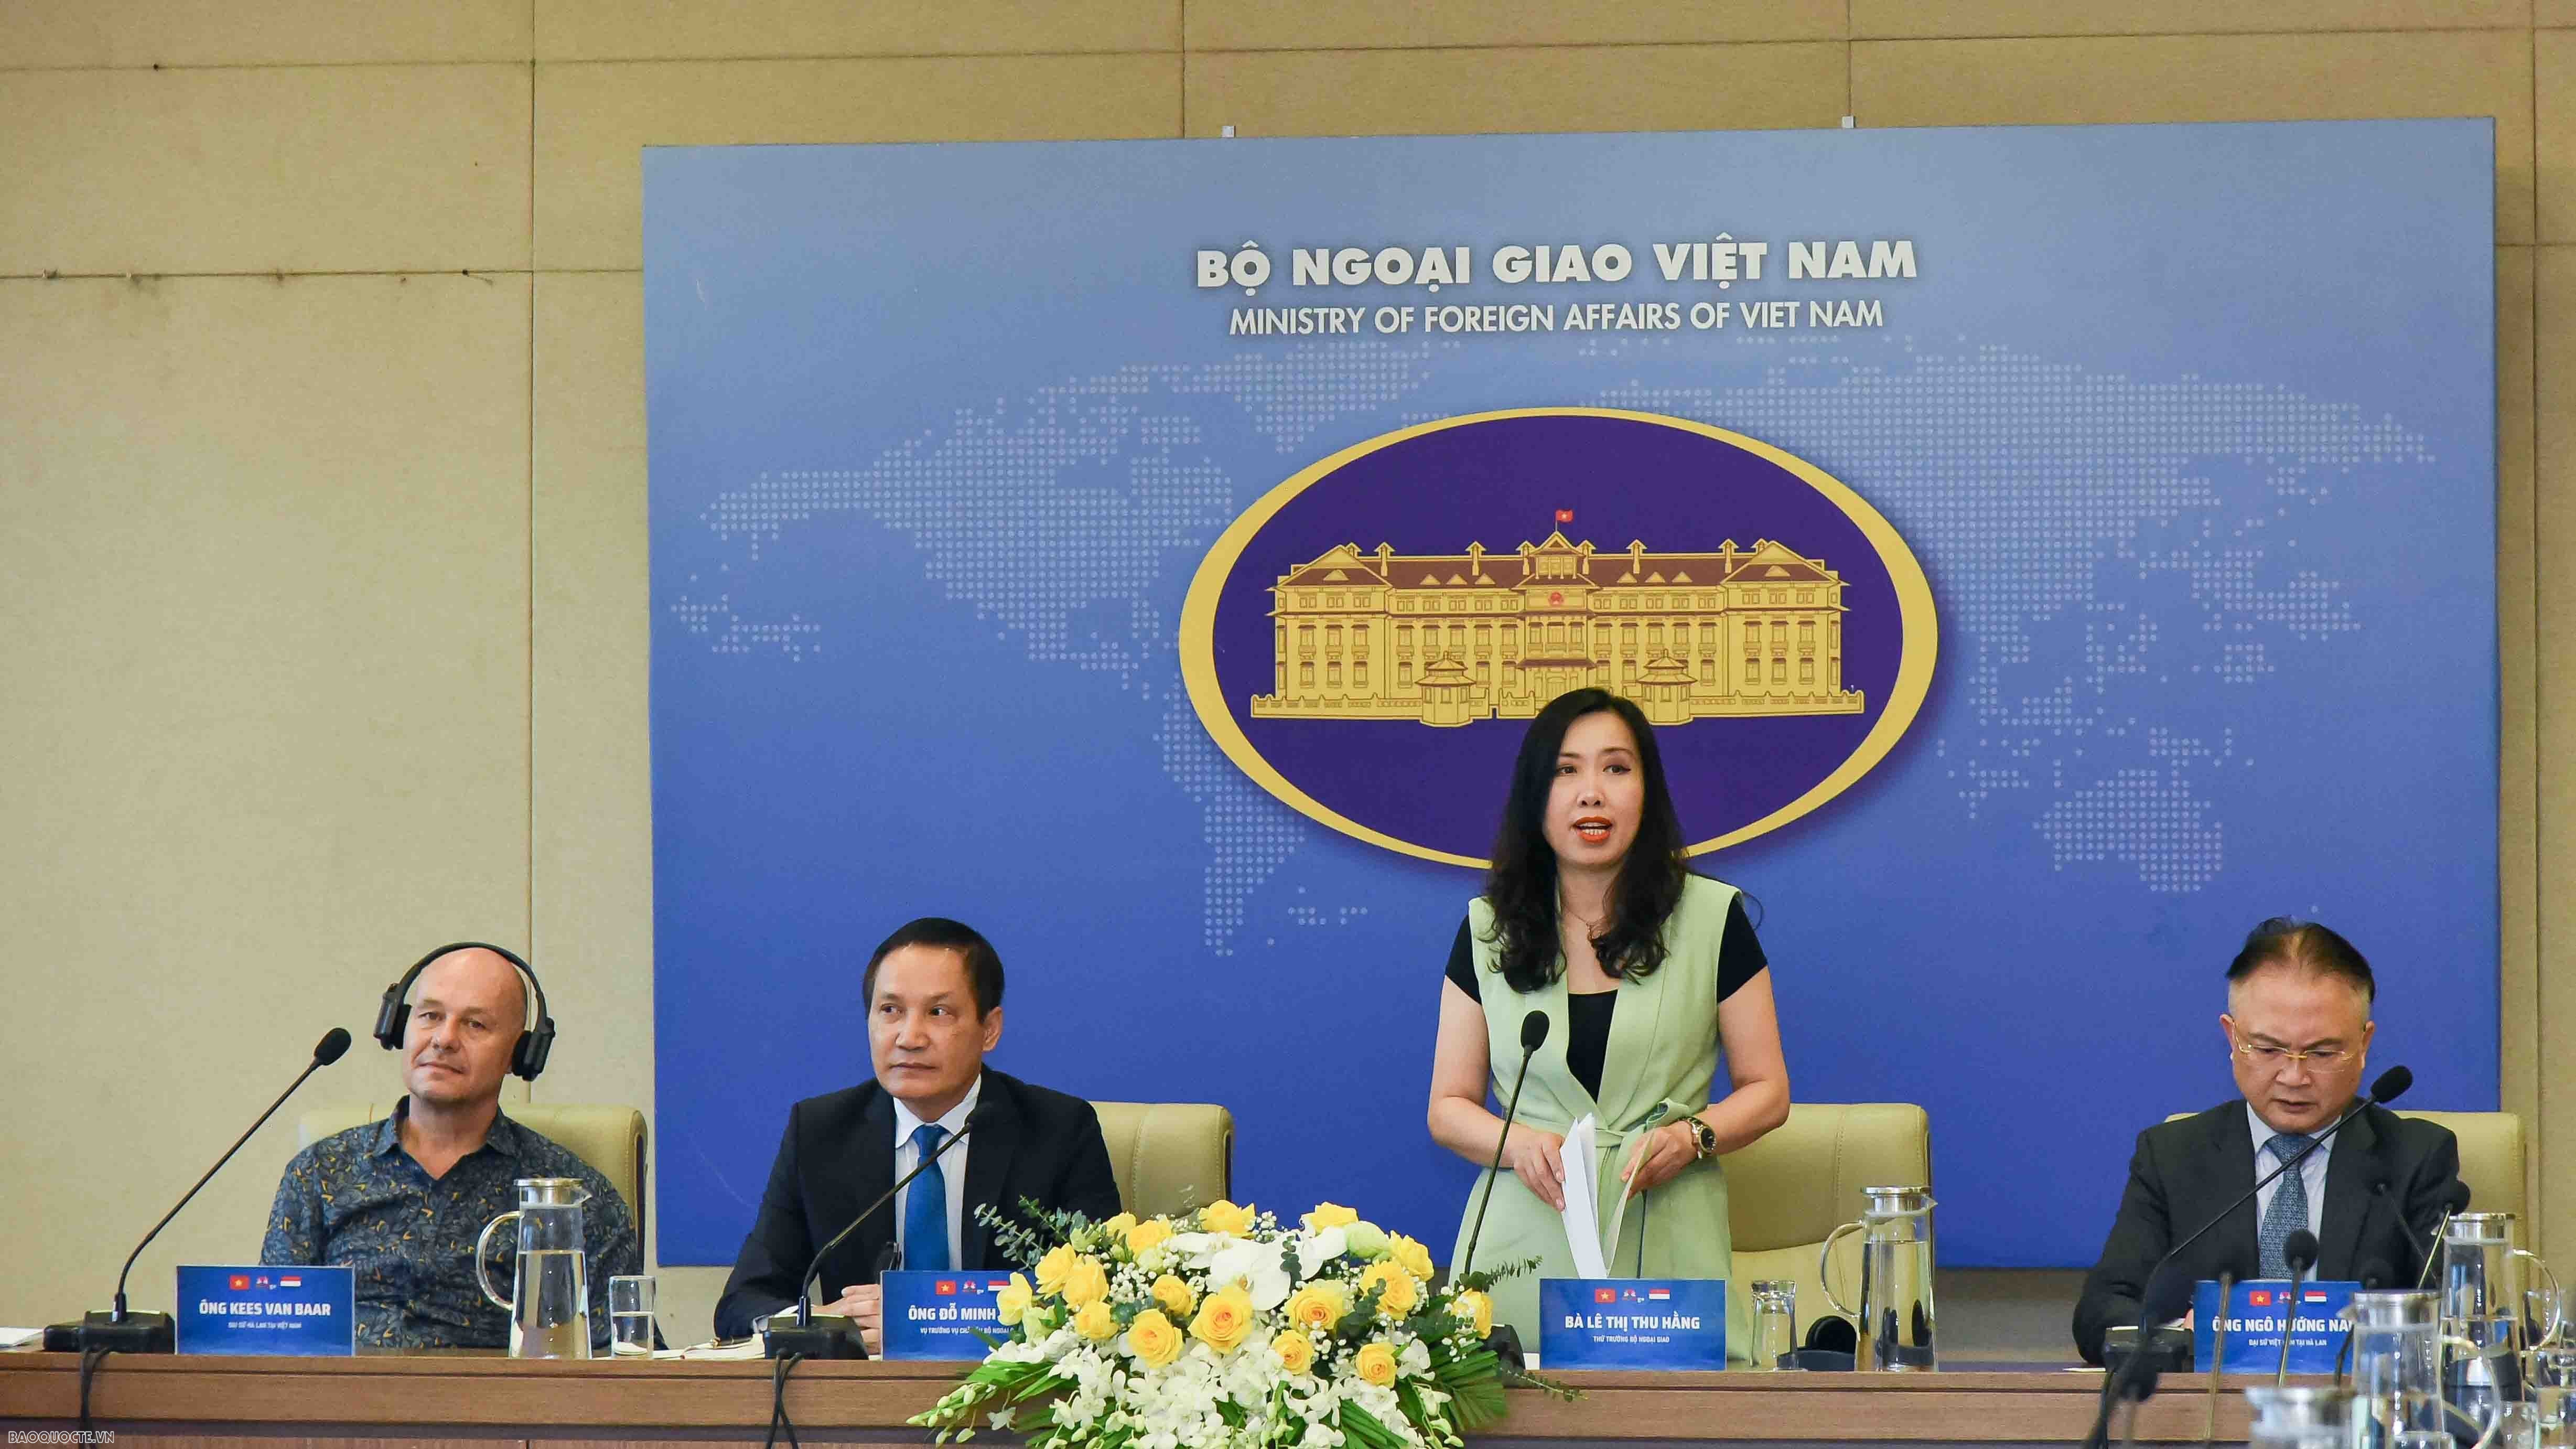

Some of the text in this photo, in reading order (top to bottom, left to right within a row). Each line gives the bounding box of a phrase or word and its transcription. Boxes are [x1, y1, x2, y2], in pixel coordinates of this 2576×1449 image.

[1198, 232, 1917, 296] BỘ NGOẠI GIAO VIỆT NAM
[1230, 300, 1883, 335] MINISTRY OF FOREIGN AFFAIRS OF VIET NAM
[230, 1302, 262, 1315] KEES
[265, 1303, 292, 1315] VAN
[295, 1303, 331, 1316] BAAR
[908, 1302, 996, 1321] ÔNG ĐỖ MINH
[1565, 1310, 1700, 1332] BÀ LÊ THỊ THU HẰNG
[2212, 1315, 2241, 1332] ÔNG
[2245, 1315, 2274, 1332] NGÔ
